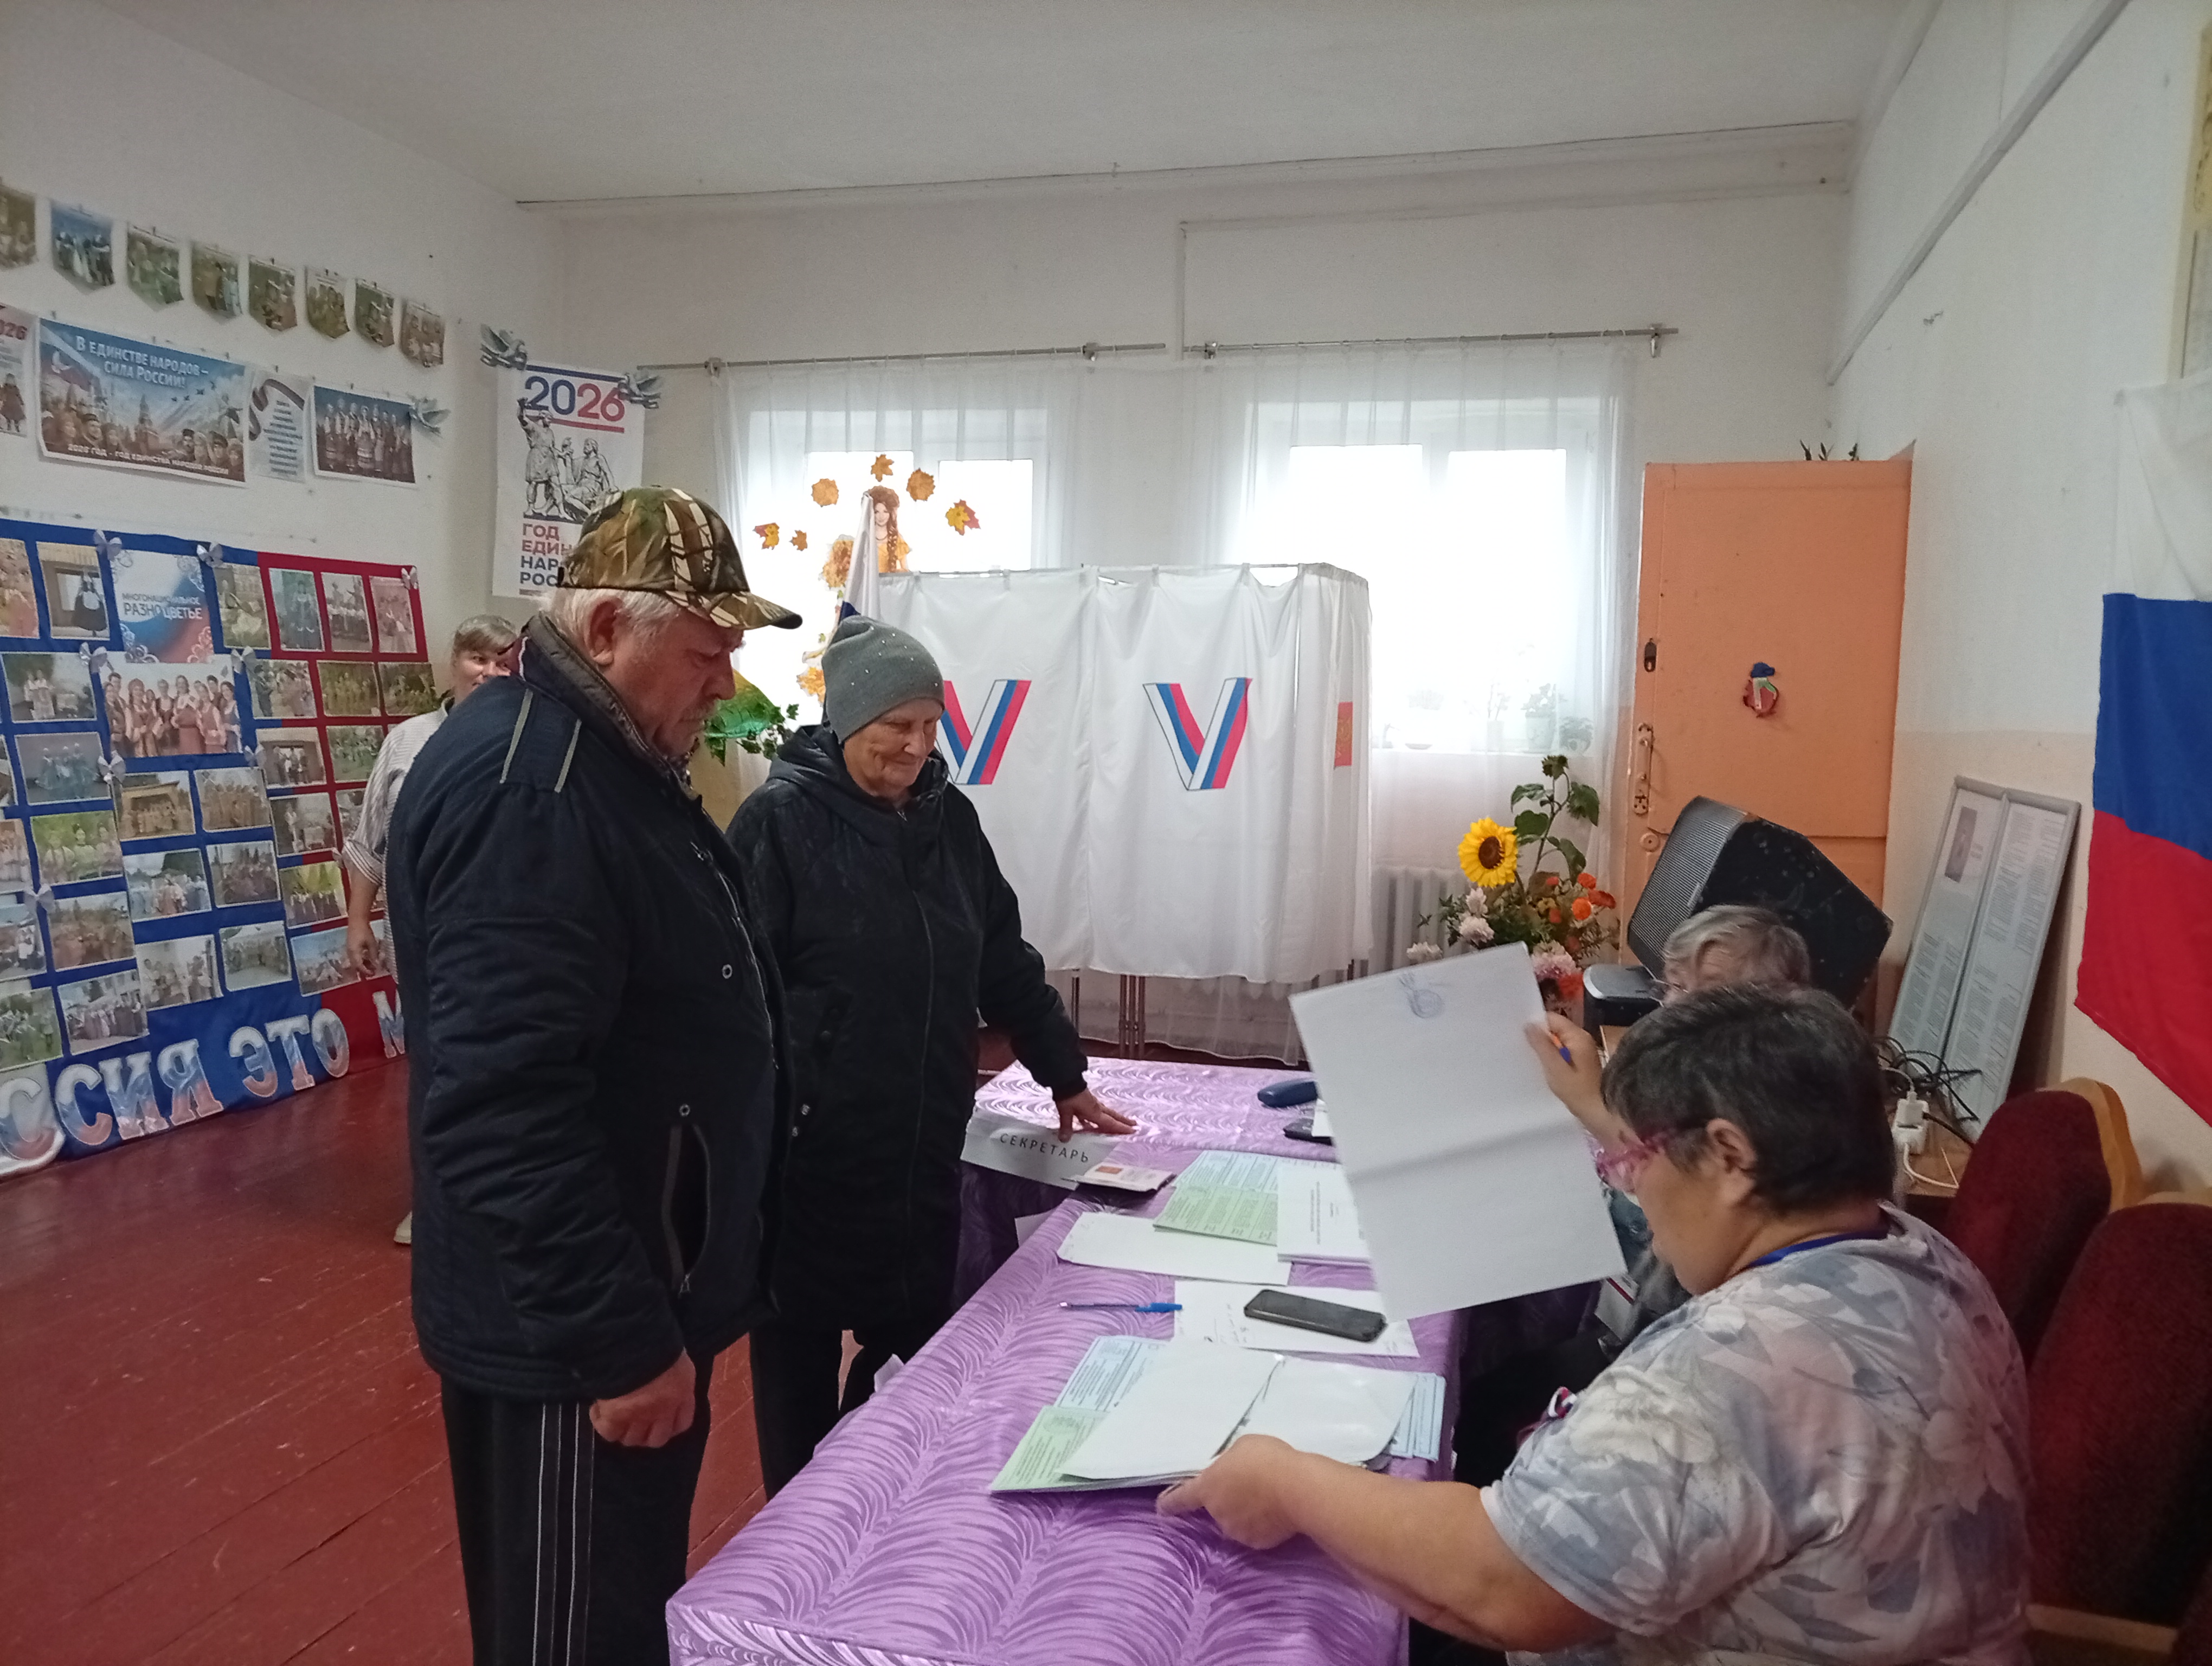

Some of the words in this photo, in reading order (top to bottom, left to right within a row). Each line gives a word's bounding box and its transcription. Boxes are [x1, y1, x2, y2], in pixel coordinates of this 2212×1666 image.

[76, 336, 86, 351] В
[89, 341, 149, 366] ЕДИНСТВЕ
[150, 355, 200, 376] НАРОДОВ
[104, 361, 134, 379] СИЛА
[525, 376, 625, 421] 2026
[523, 523, 560, 541] ГОД
[123, 602, 203, 620] РАЗНОЦВЕТЬЕ
[229, 1008, 350, 1098] ЭТО
[999, 1133, 1089, 1163] СЕКРЕТАРЬ
